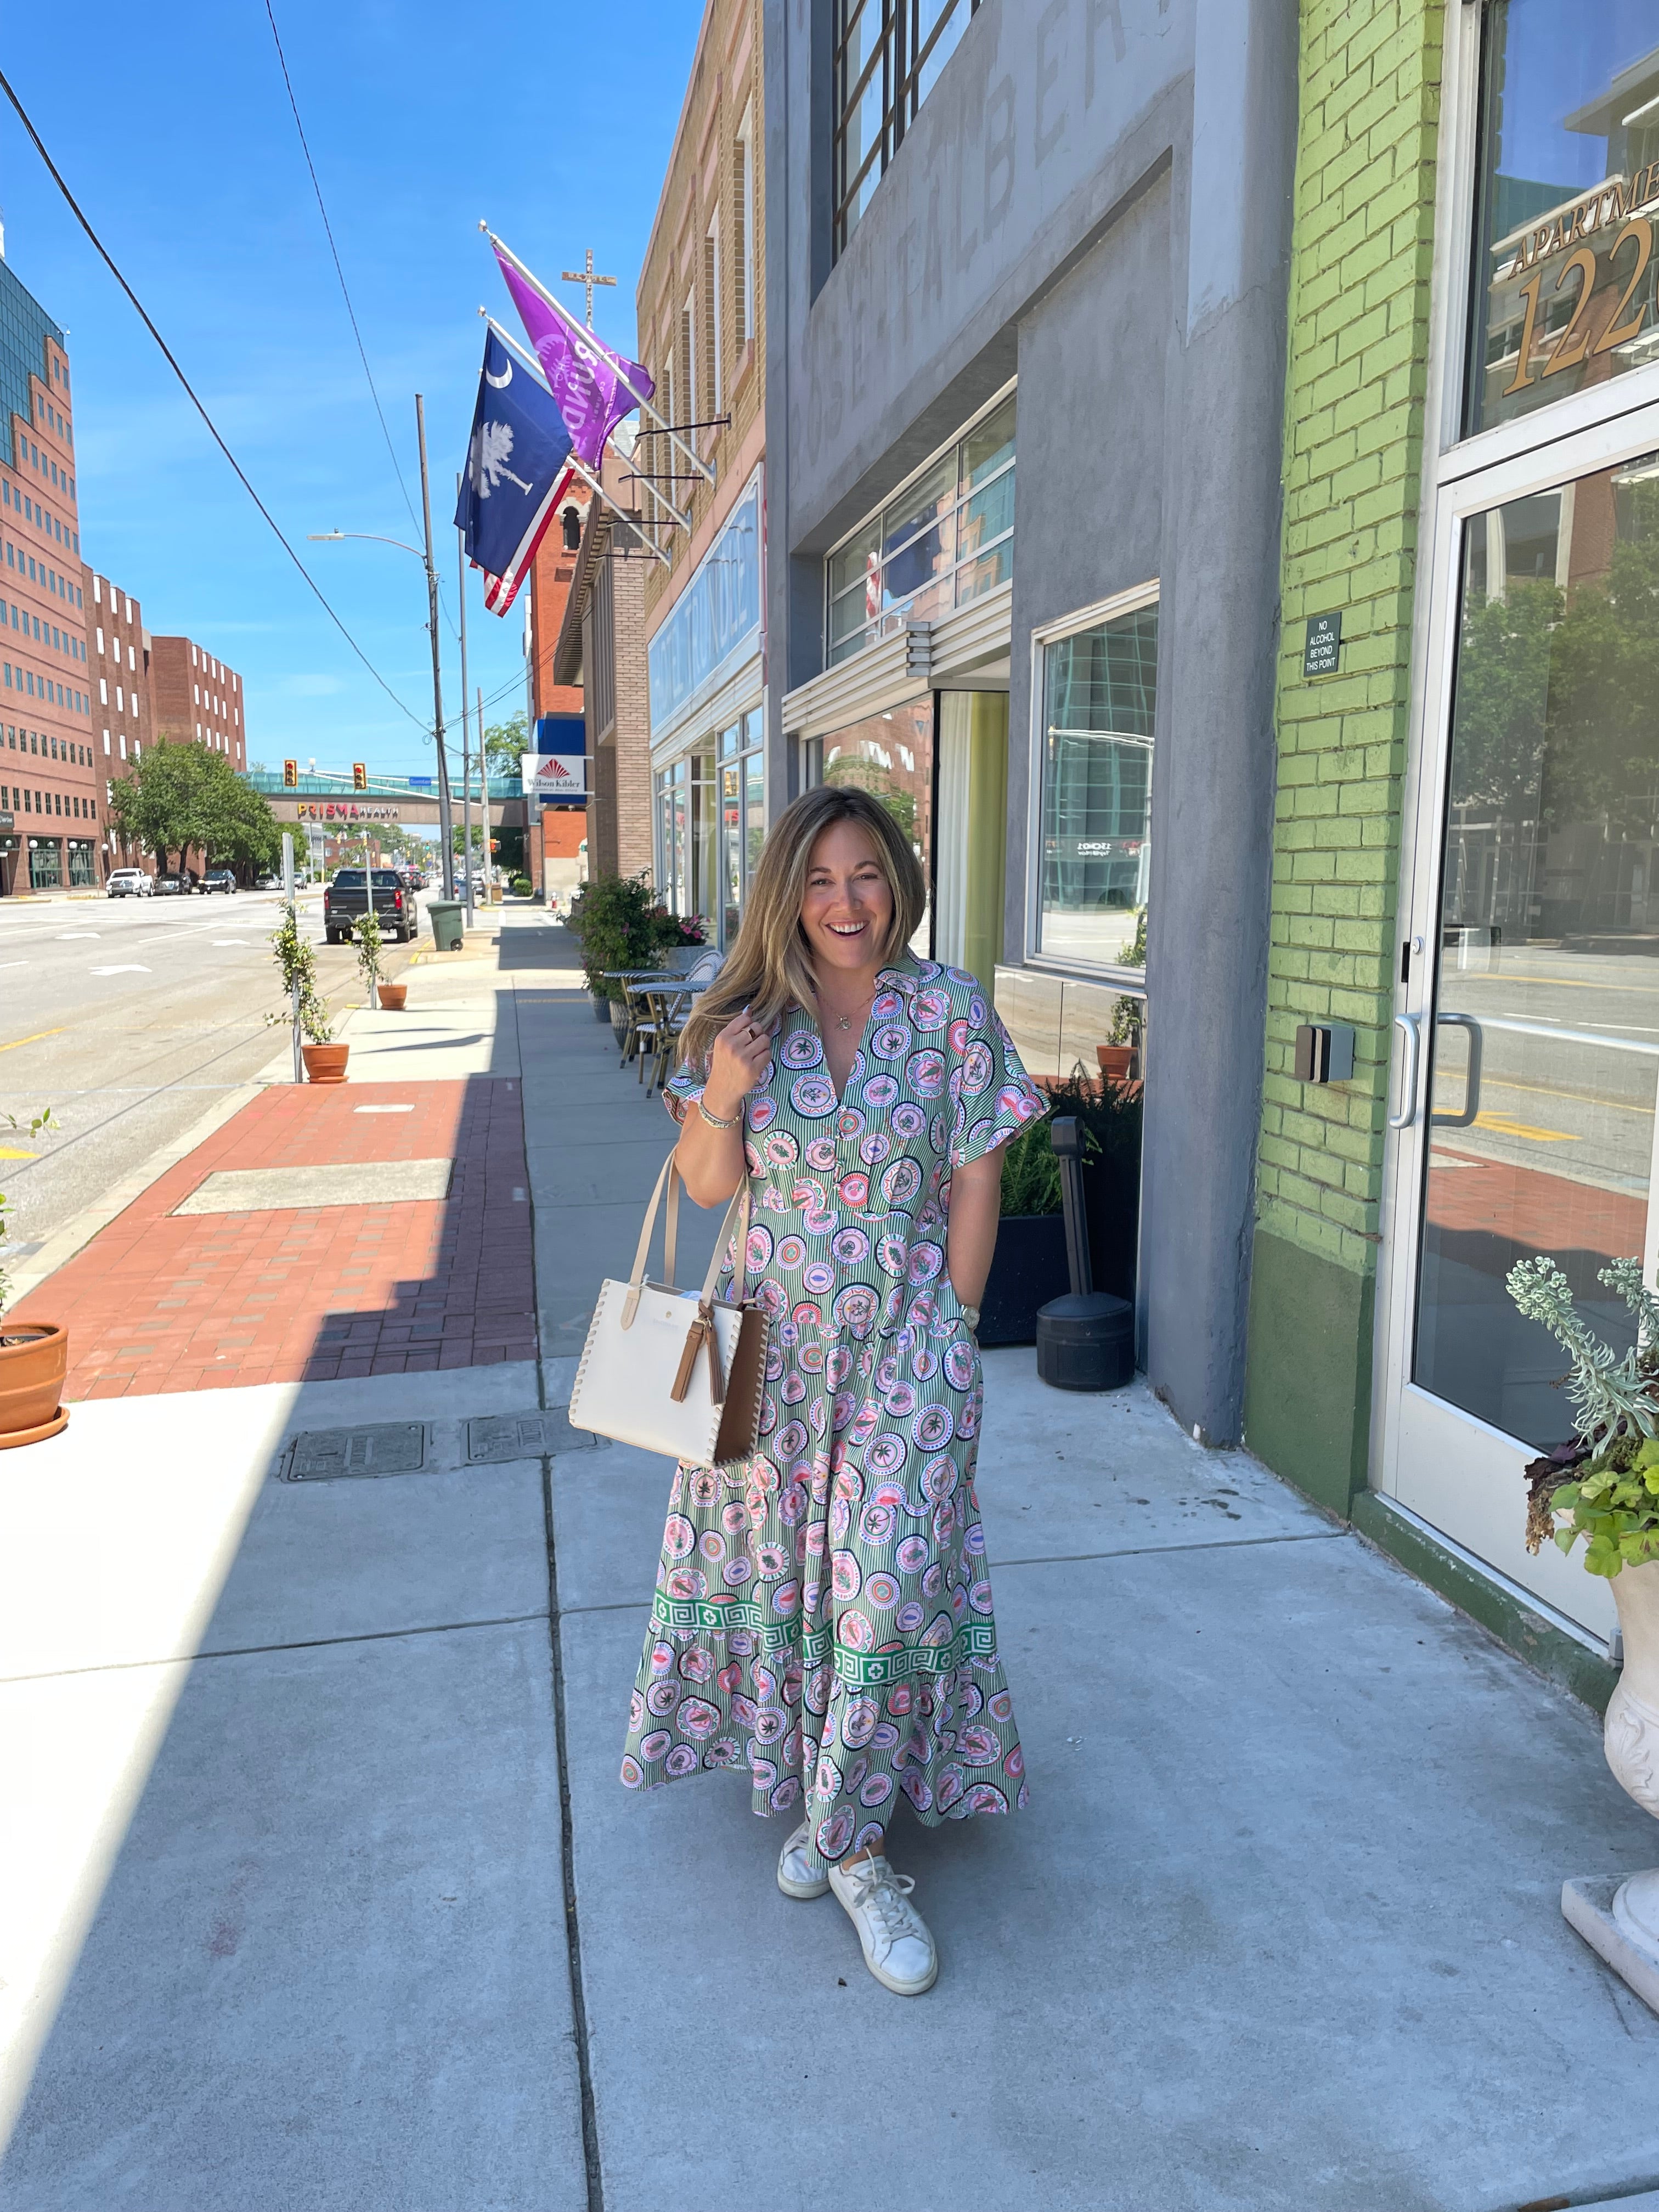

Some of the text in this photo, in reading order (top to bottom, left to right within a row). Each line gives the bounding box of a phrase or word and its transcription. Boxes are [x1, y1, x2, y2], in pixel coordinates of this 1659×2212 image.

[1502, 217, 1659, 398] 122
[1318, 620, 1328, 631] NO
[1310, 631, 1335, 646] ALCOHOL
[1310, 645, 1333, 658] BEYOND
[1306, 657, 1336, 672] THIS POINT
[527, 778, 580, 788] Wilson Kibler
[297, 803, 359, 816] PRISMA
